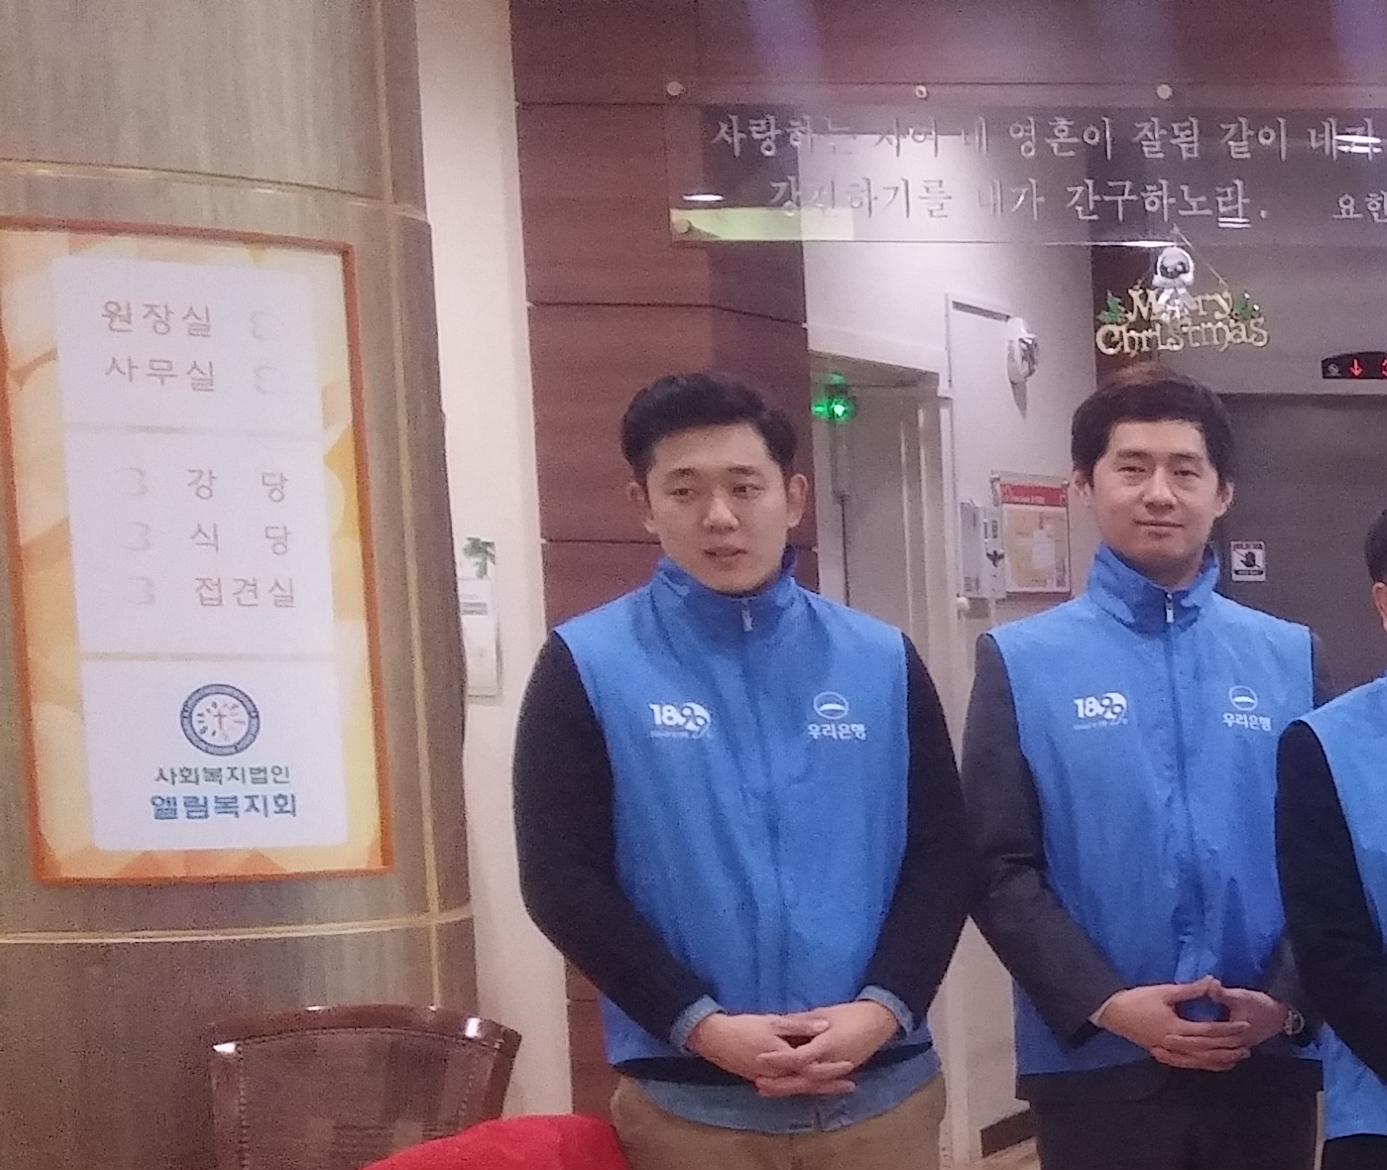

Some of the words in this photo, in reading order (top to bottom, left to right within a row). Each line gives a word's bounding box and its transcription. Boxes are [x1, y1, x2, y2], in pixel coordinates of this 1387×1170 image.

[1009, 116, 1113, 161] 영혼이
[1133, 116, 1200, 160] 잘됨
[1220, 116, 1288, 162] 같이
[101, 300, 213, 338] 원장실
[1095, 316, 1269, 358] Christmas
[104, 355, 216, 393] 사무실
[194, 576, 296, 609] 접견실
[807, 722, 868, 741] 우리은행
[1222, 711, 1273, 732] 우리은행
[154, 764, 292, 787] 사회복지법인
[150, 792, 298, 821] 엘림복지회
